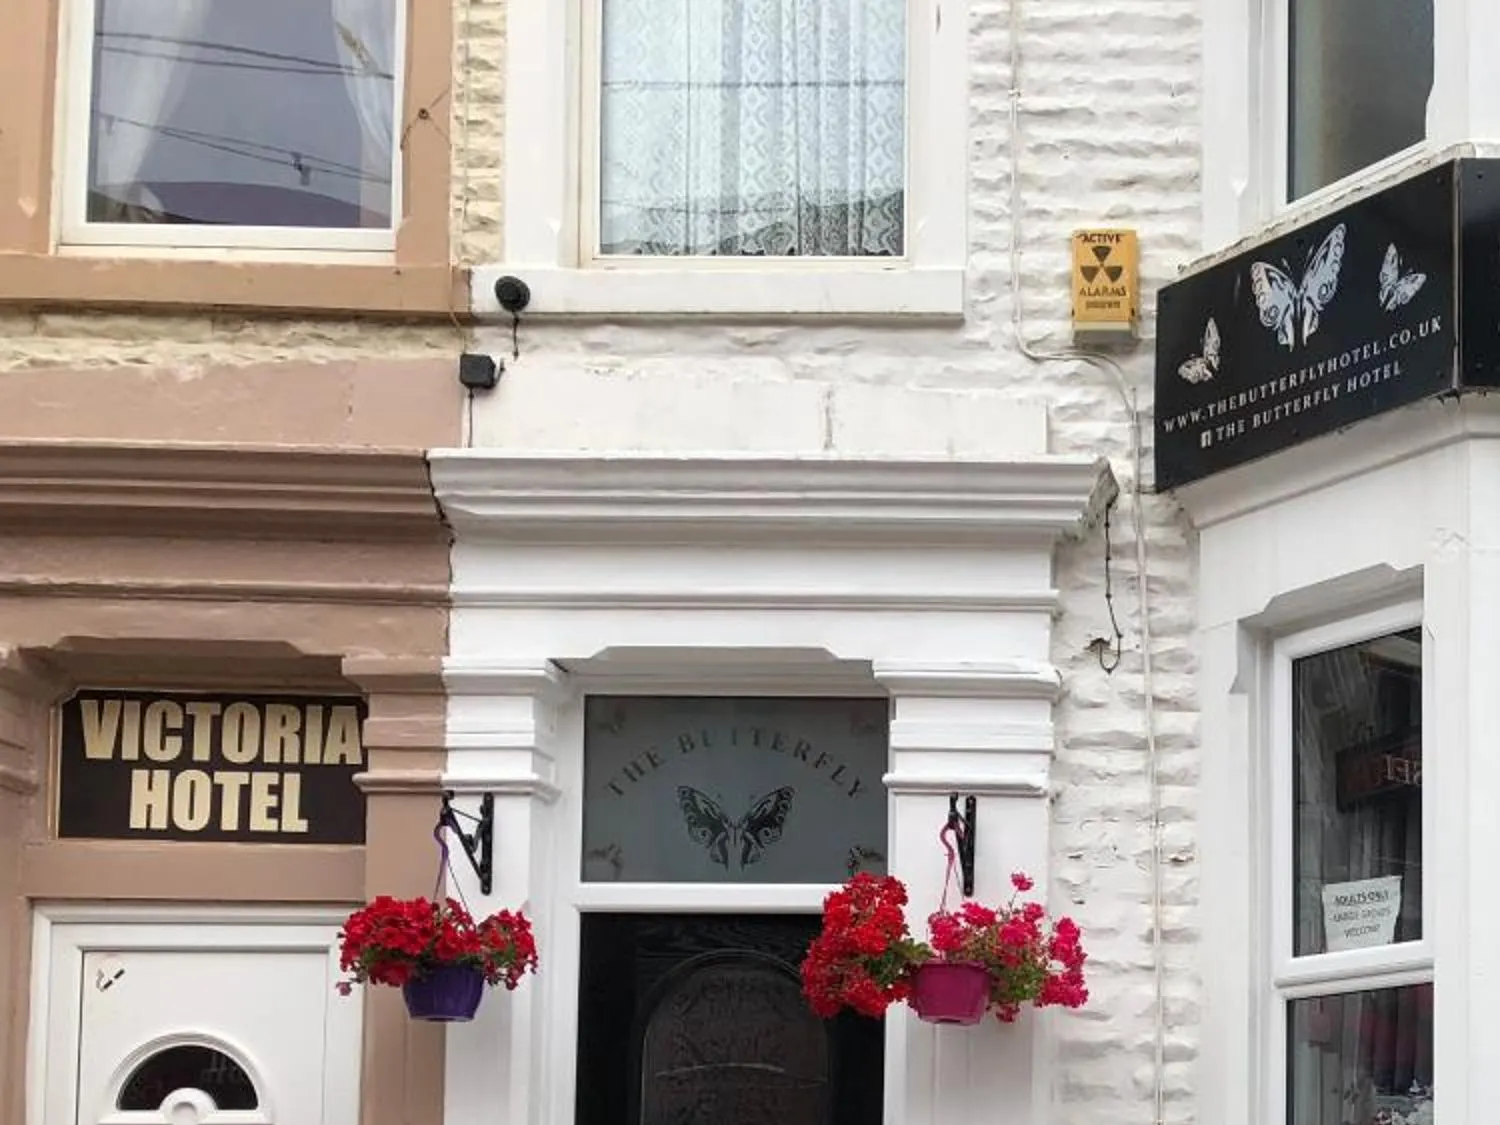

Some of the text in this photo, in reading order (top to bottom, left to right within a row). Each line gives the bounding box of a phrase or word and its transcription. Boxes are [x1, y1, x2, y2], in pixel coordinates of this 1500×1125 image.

[1079, 285, 1127, 298] ALARMS
[1163, 316, 1442, 433] WWW.THEBUTTERFLYHOTEL.CO.UK
[1215, 361, 1403, 442] THE BUTTERFLY HOTEL
[80, 699, 363, 765] VICTORIA
[605, 726, 866, 798] THE BUTTERFLY
[129, 769, 309, 833] HOTEL
